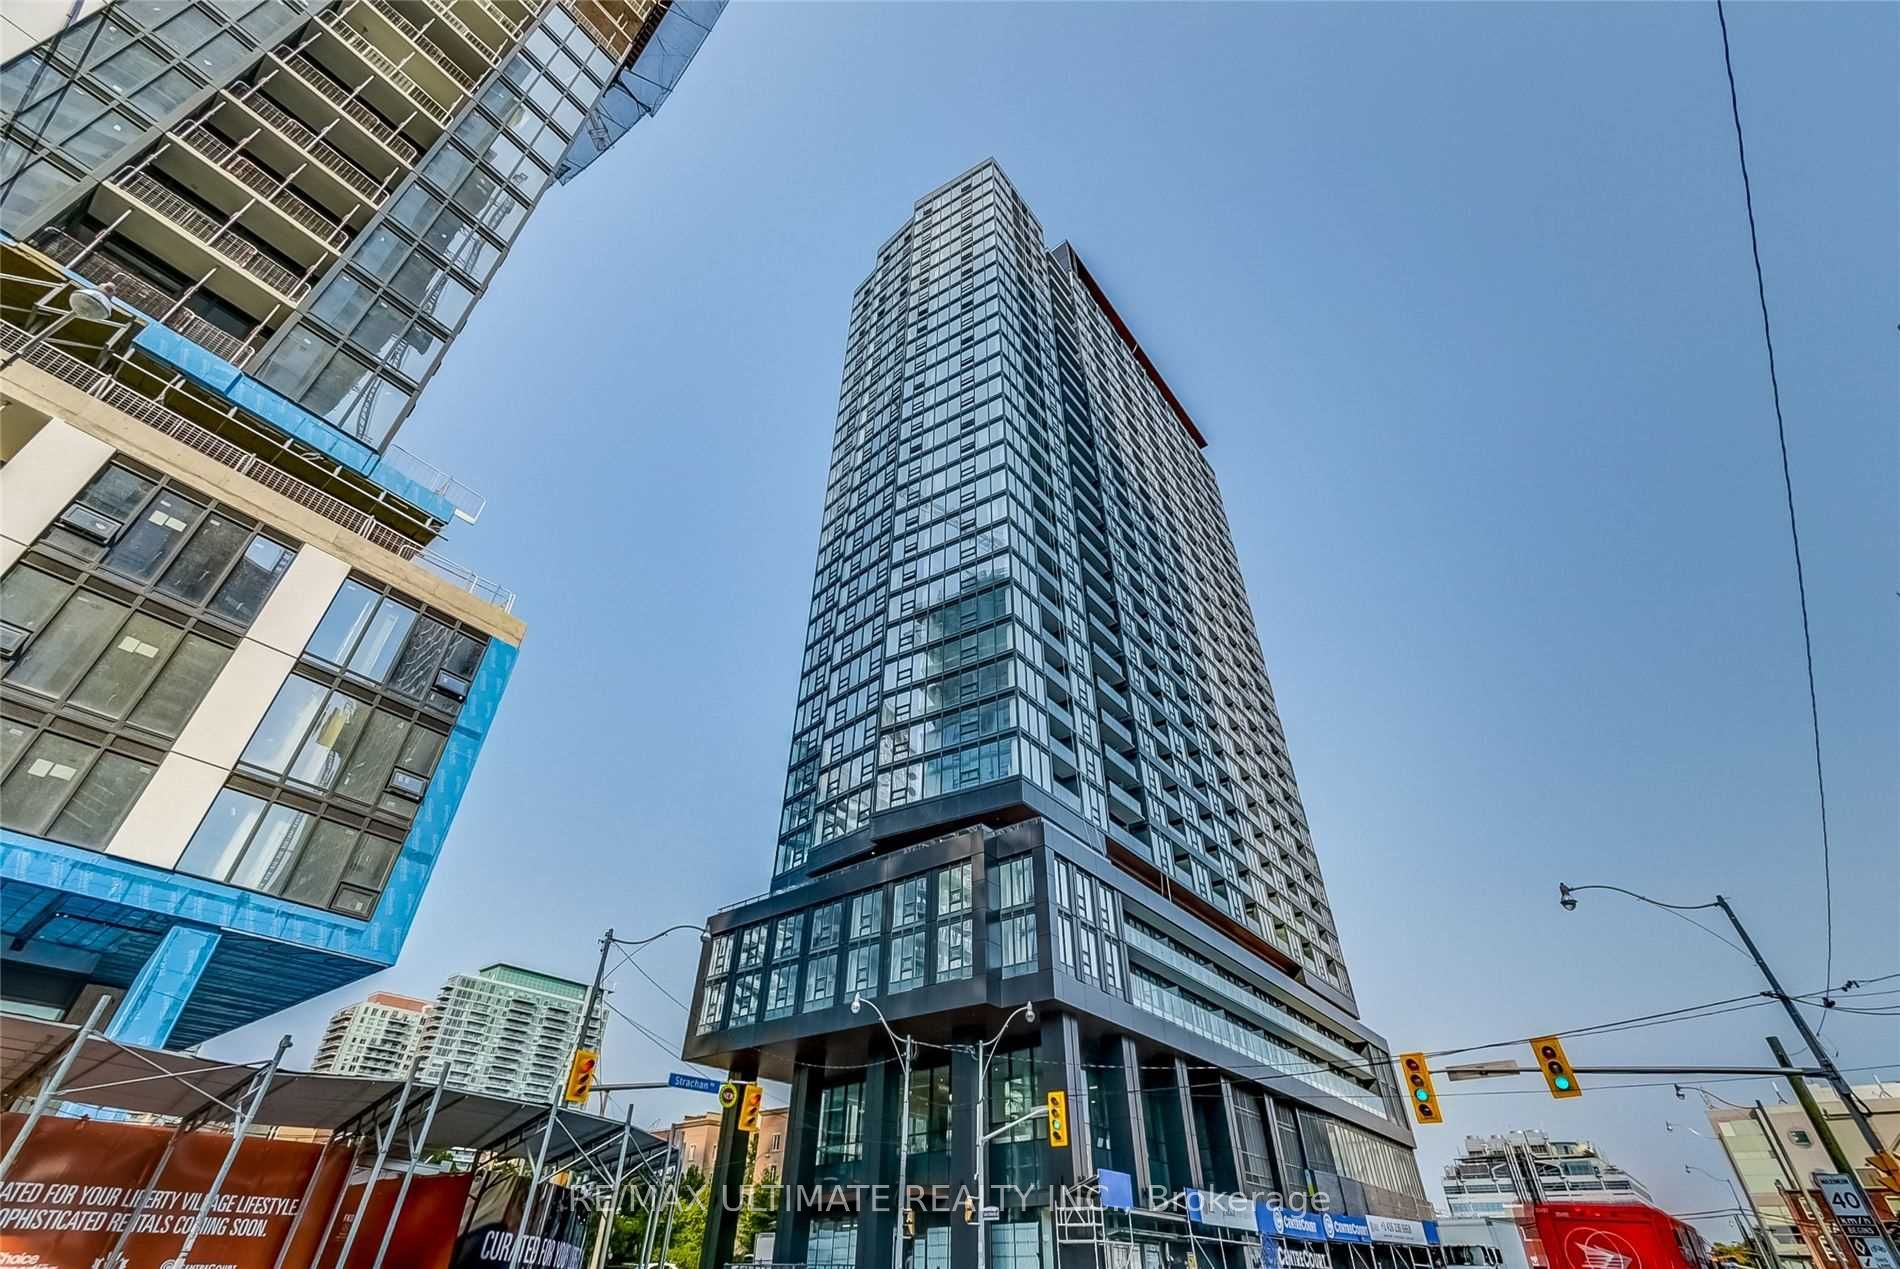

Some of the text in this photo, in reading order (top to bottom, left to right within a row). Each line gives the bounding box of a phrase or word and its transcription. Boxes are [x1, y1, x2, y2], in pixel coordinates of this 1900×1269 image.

[674, 1076, 709, 1090] Strachan
[41, 1183, 79, 1204] FOR
[78, 1185, 122, 1207] YOUR
[181, 1191, 239, 1213] VILAGE
[1832, 1191, 1861, 1209] 40
[229, 1218, 268, 1238] SOON.
[1840, 1216, 1872, 1226] km/h
